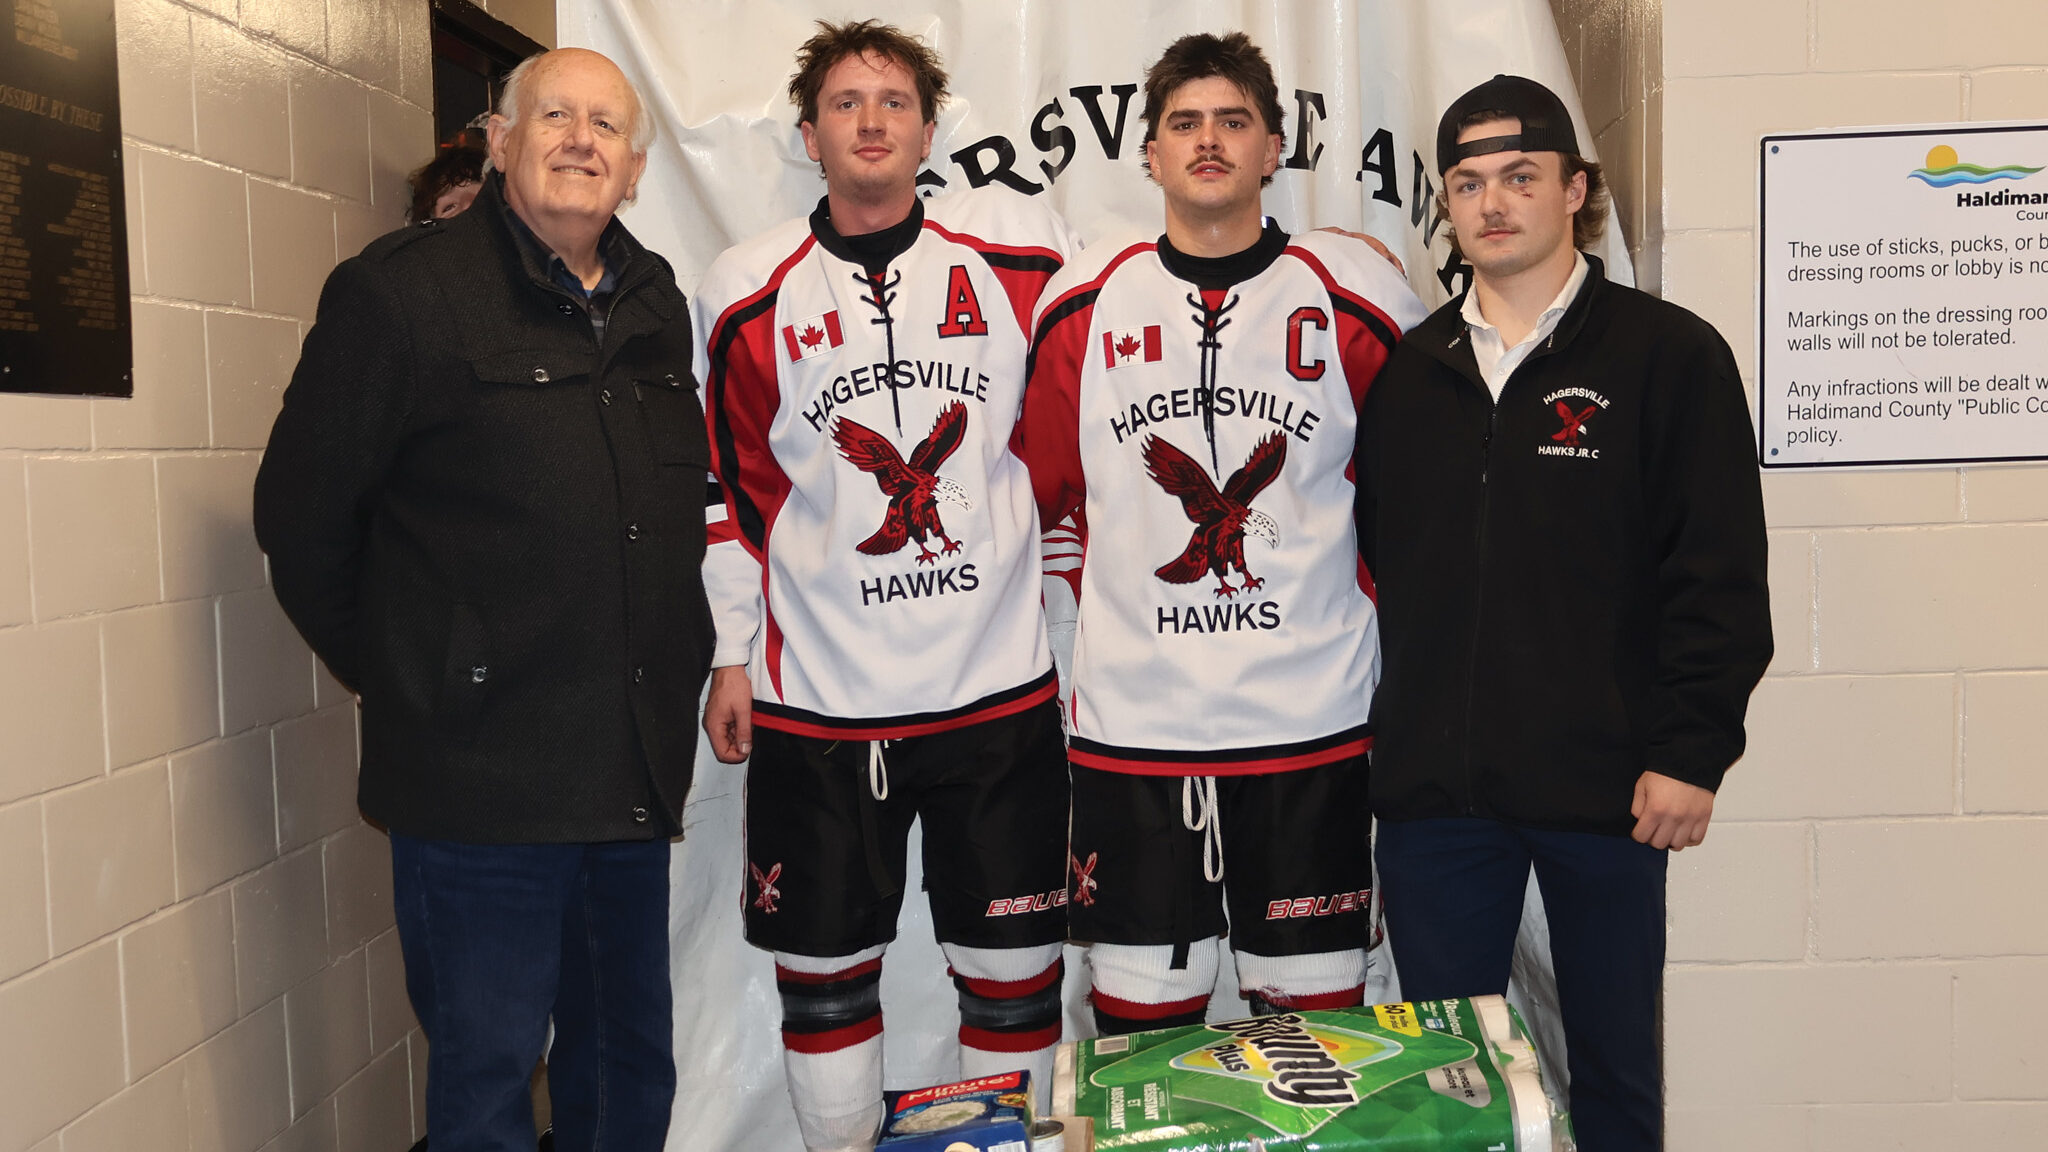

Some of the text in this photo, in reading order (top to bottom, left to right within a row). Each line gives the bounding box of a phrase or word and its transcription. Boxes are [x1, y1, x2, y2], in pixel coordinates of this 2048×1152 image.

[51, 99, 68, 122] BY
[70, 104, 104, 132] THESE
[1787, 241, 1822, 259] The
[1828, 243, 1860, 258] use
[1866, 238, 1885, 256] of
[1888, 236, 1944, 256] sticks,
[1950, 234, 2008, 258] pucks,
[2014, 236, 2034, 251] or
[1787, 263, 1863, 285] dressing
[1869, 264, 1925, 279] rooms
[1930, 263, 1950, 277] or
[1955, 258, 2004, 280] lobby
[2009, 256, 2024, 275] is
[937, 265, 989, 338] A
[1788, 309, 1869, 331] Markings
[1874, 312, 1897, 326] on
[1902, 307, 1931, 325] the
[1936, 304, 2013, 326] dressing
[1286, 306, 1329, 382] C
[1787, 327, 2016, 352] walls will not be tolerated.
[801, 359, 990, 433] HAGERSVILLE
[1542, 387, 1611, 410] HAGERSVILLE
[1786, 380, 1822, 402] Any
[1827, 377, 1919, 397] infractions
[1923, 375, 1952, 394] will
[1958, 375, 1980, 393] be
[1986, 373, 2030, 392] dealt
[1110, 387, 1320, 444] HAGERSVILLE
[1787, 400, 1882, 421] Haldimand
[1888, 400, 1953, 421] County
[1957, 397, 2020, 416] "Public
[1787, 426, 1843, 448] policy.
[1537, 445, 1600, 459] HAWKS JR. C
[860, 563, 980, 606] HAWKS
[1156, 601, 1281, 634] HAWKS
[985, 888, 1068, 917] BAUE
[1204, 1012, 1362, 1108] Bounty
[1464, 1089, 1476, 1098] et
